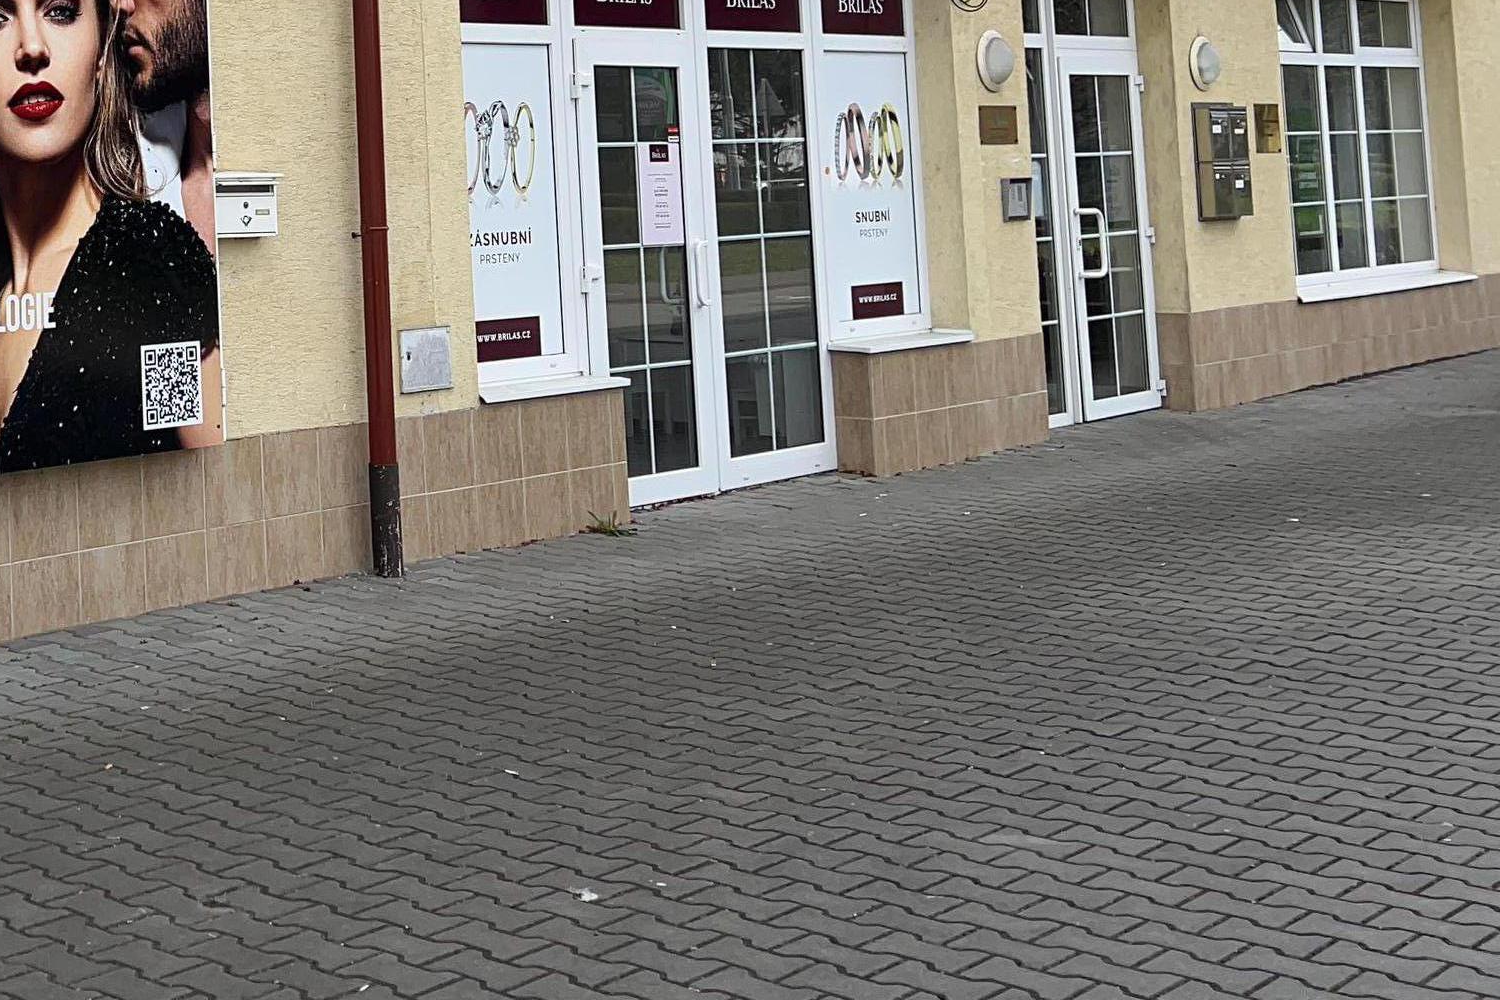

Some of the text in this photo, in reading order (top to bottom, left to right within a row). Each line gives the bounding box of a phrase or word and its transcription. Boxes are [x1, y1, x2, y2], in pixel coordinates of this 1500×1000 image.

[855, 207, 891, 223] SNUBNÍ
[479, 252, 521, 265] PRSTENY
[476, 331, 532, 343] WWW.BRILAS.CZ
